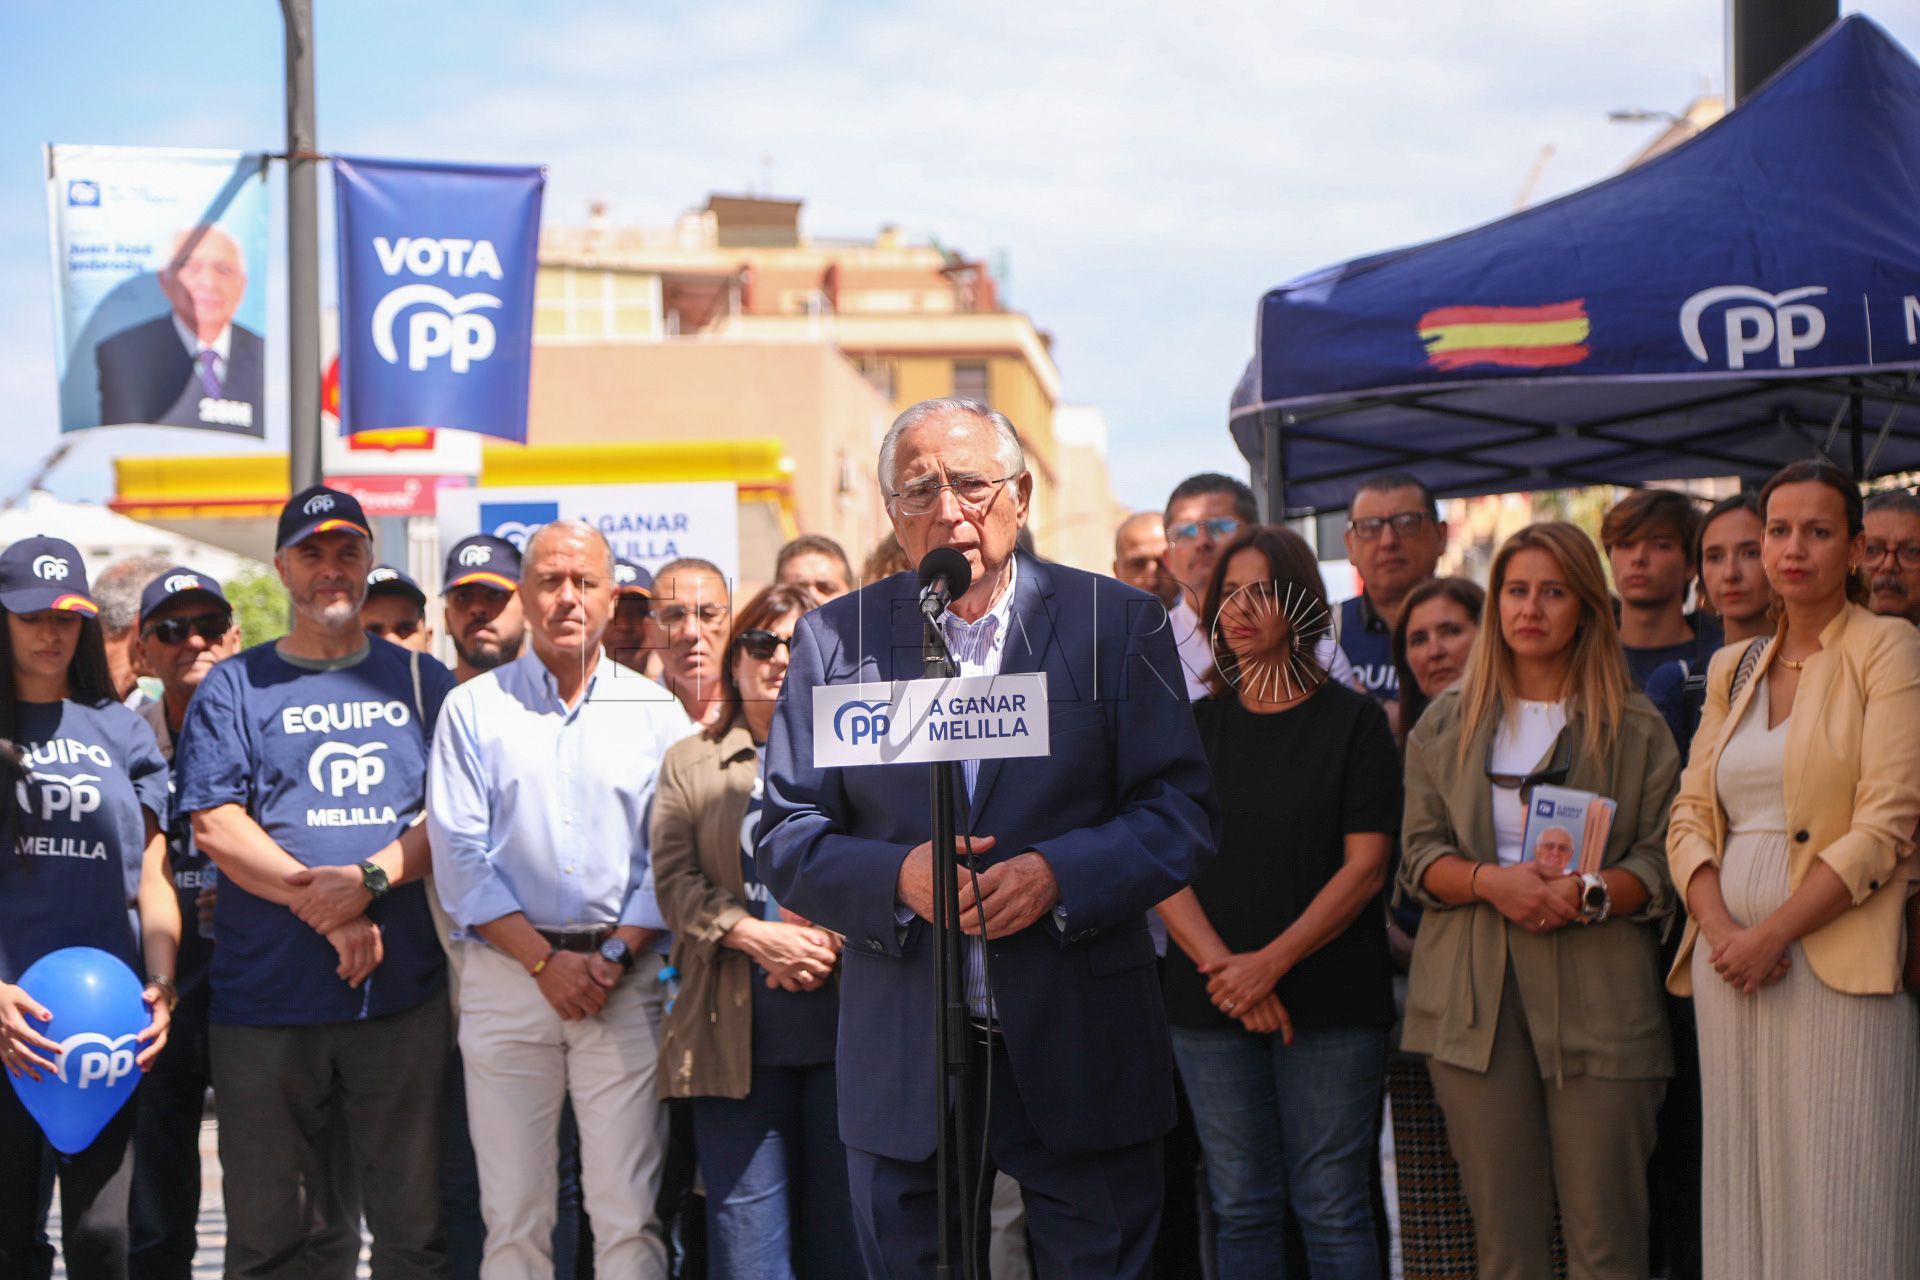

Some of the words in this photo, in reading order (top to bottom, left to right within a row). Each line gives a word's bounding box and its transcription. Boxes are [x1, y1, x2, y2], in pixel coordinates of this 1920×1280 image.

[372, 236, 504, 281] VOTA
[599, 513, 688, 532] GANAR
[611, 541, 679, 558] LILLA
[282, 700, 411, 735] EQUIPO
[928, 699, 945, 717] A
[949, 694, 1026, 715] GANAR
[928, 717, 1029, 742] MELILLA
[18, 738, 113, 769] QUIPO
[306, 806, 398, 827] MELILLA
[15, 836, 108, 860] MELILLA
